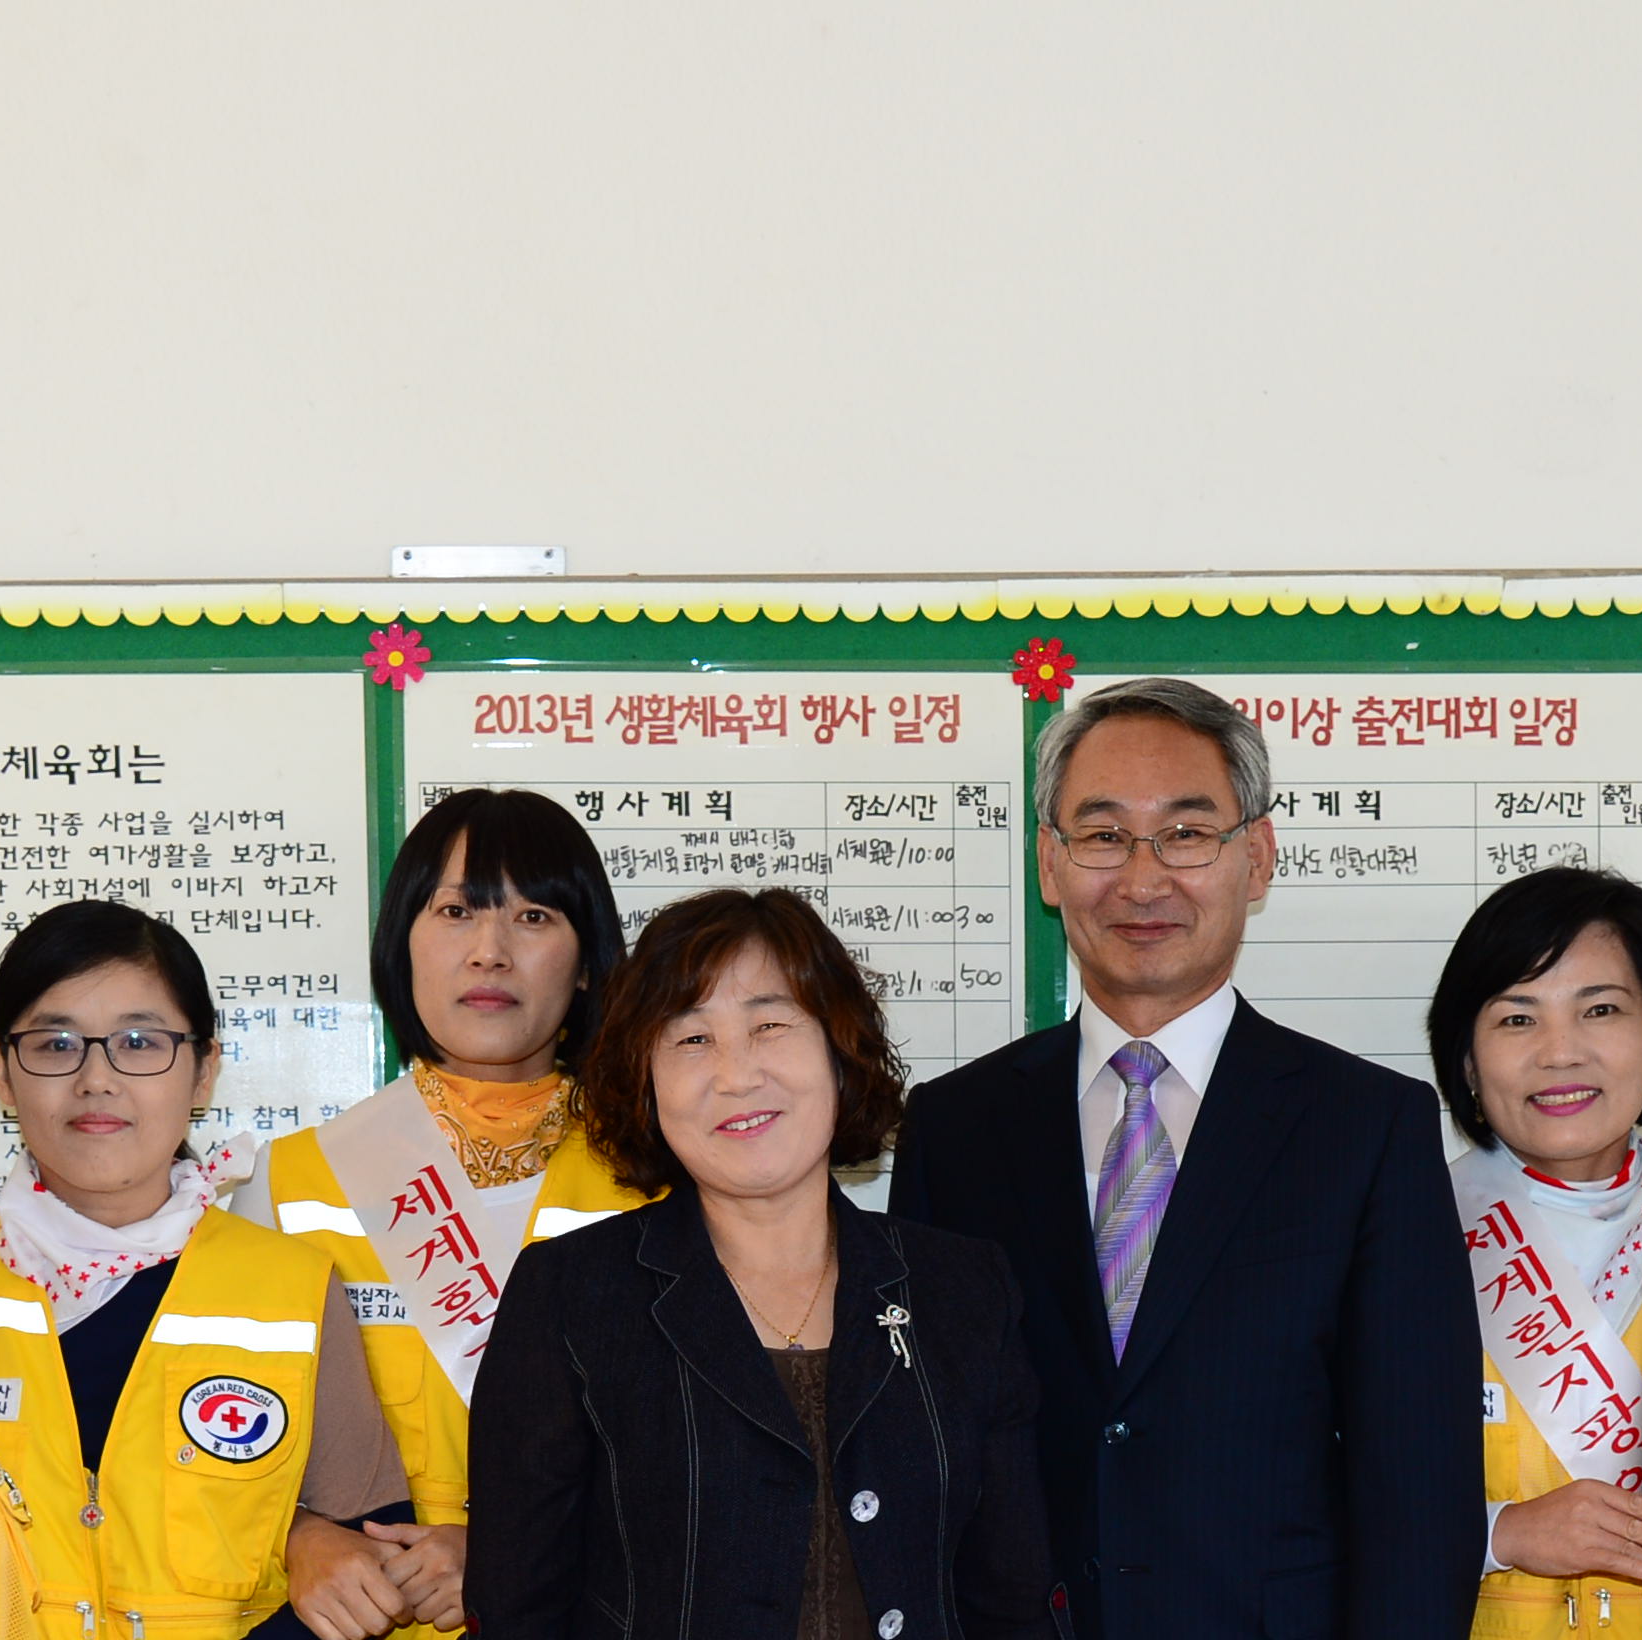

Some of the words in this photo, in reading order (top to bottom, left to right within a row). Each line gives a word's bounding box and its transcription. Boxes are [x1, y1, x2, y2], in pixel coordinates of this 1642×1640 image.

[474, 694, 594, 744] 2013년
[605, 694, 788, 745] 생활체육회
[801, 694, 876, 745] 행사
[887, 694, 962, 745] 일정
[1352, 695, 1498, 747] 출전대회
[1509, 696, 1579, 747] 일정
[845, 793, 938, 822] 장소/시간
[956, 784, 988, 807] 출전
[1495, 790, 1586, 819] 장소/시간
[1601, 784, 1632, 806] 출전
[35, 811, 84, 838] 각종
[98, 811, 172, 836] 사업을
[187, 809, 285, 836] 실시하여
[975, 806, 1008, 828] 인원
[89, 844, 212, 869] 여가생활을
[231, 842, 337, 868] 보장하고,
[1275, 842, 1323, 878] 상남도
[26, 876, 151, 901] 사회건설에
[171, 875, 244, 898] 이바지
[263, 875, 338, 898] 하고자
[191, 908, 322, 934] 단체입니다.
[216, 973, 339, 999] 근무여건의
[960, 963, 1002, 989] 500
[293, 1006, 341, 1031] 대한
[253, 1105, 300, 1130] 참여
[191, 1382, 226, 1405] KOREAN
[226, 1383, 245, 1395] RED
[245, 1389, 274, 1408] CROSS
